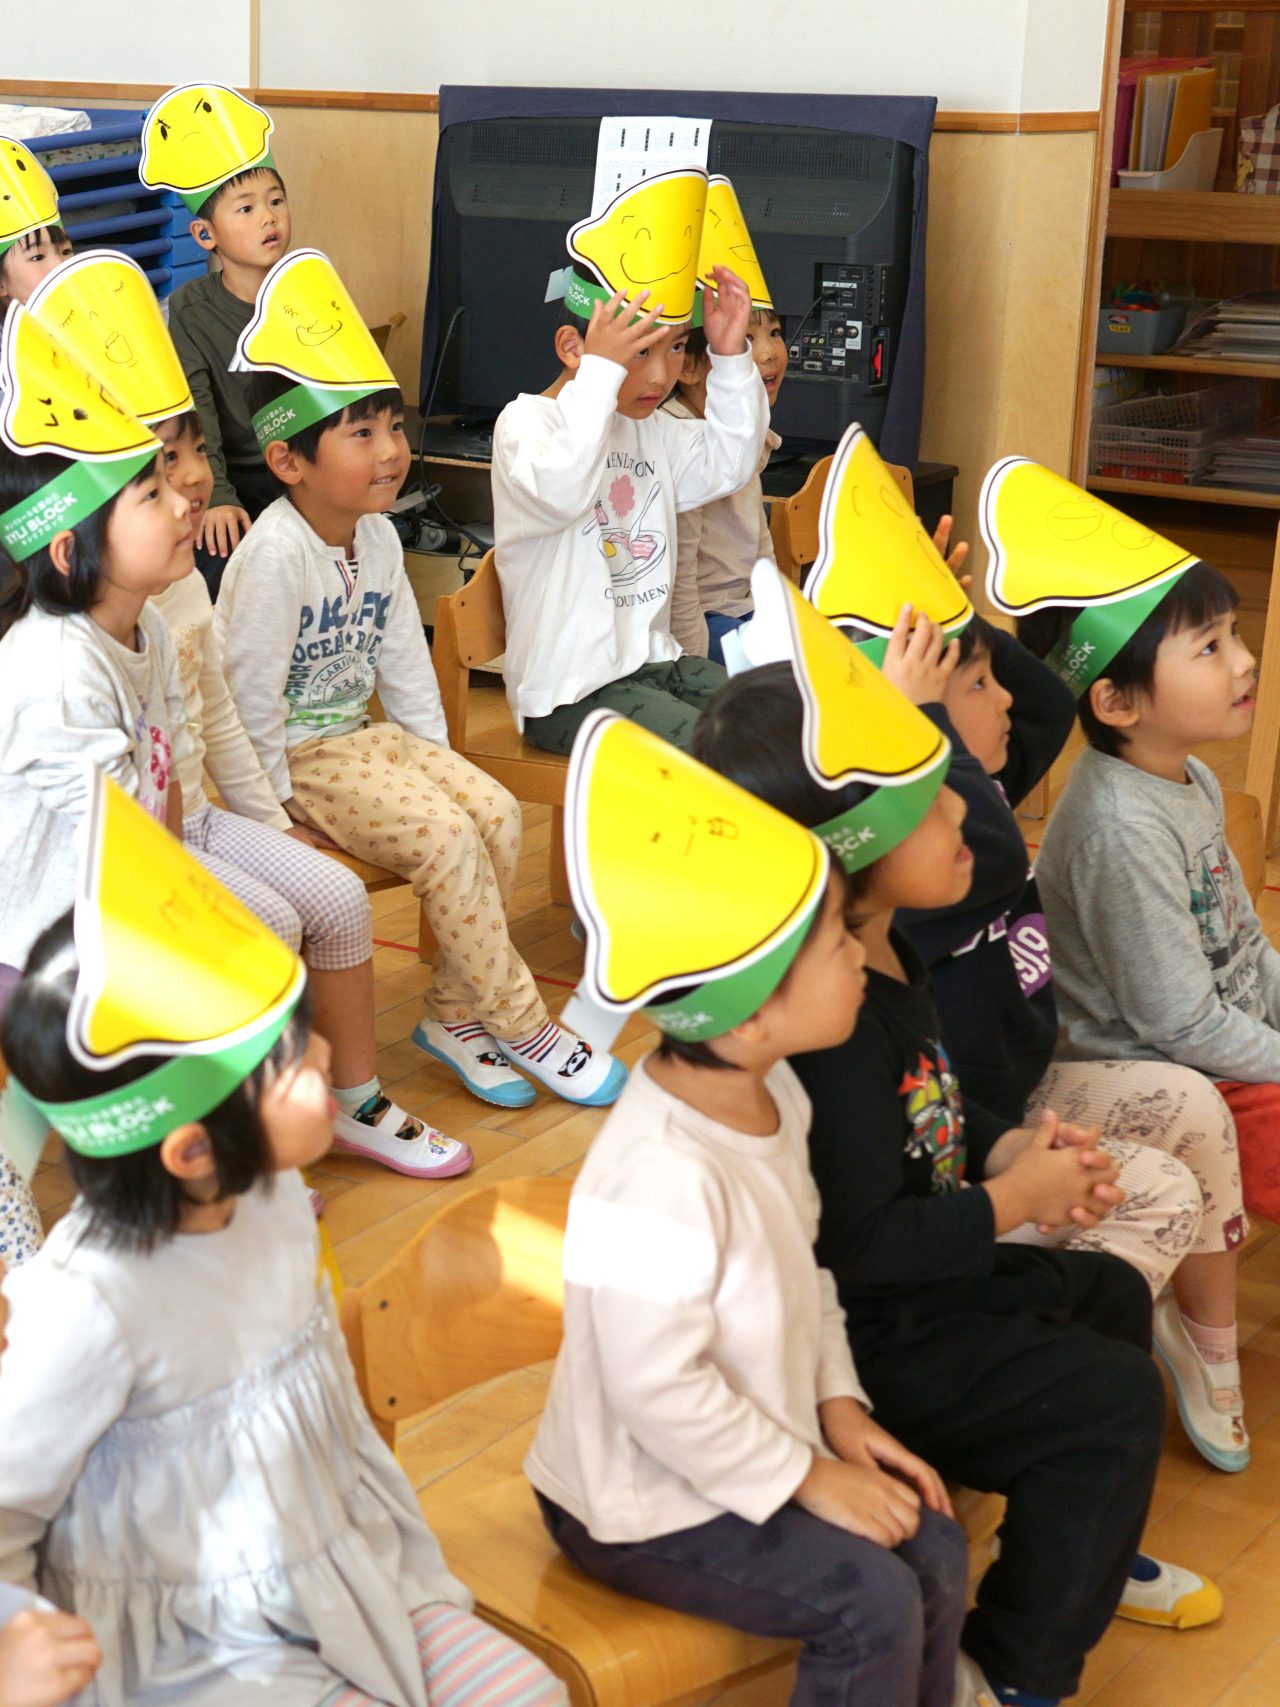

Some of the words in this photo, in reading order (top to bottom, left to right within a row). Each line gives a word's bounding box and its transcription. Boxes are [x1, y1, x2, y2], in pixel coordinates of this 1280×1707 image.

[263, 409, 297, 434] BLOCK
[26, 492, 77, 531] BLOCK
[1060, 641, 1096, 680] BLOCK
